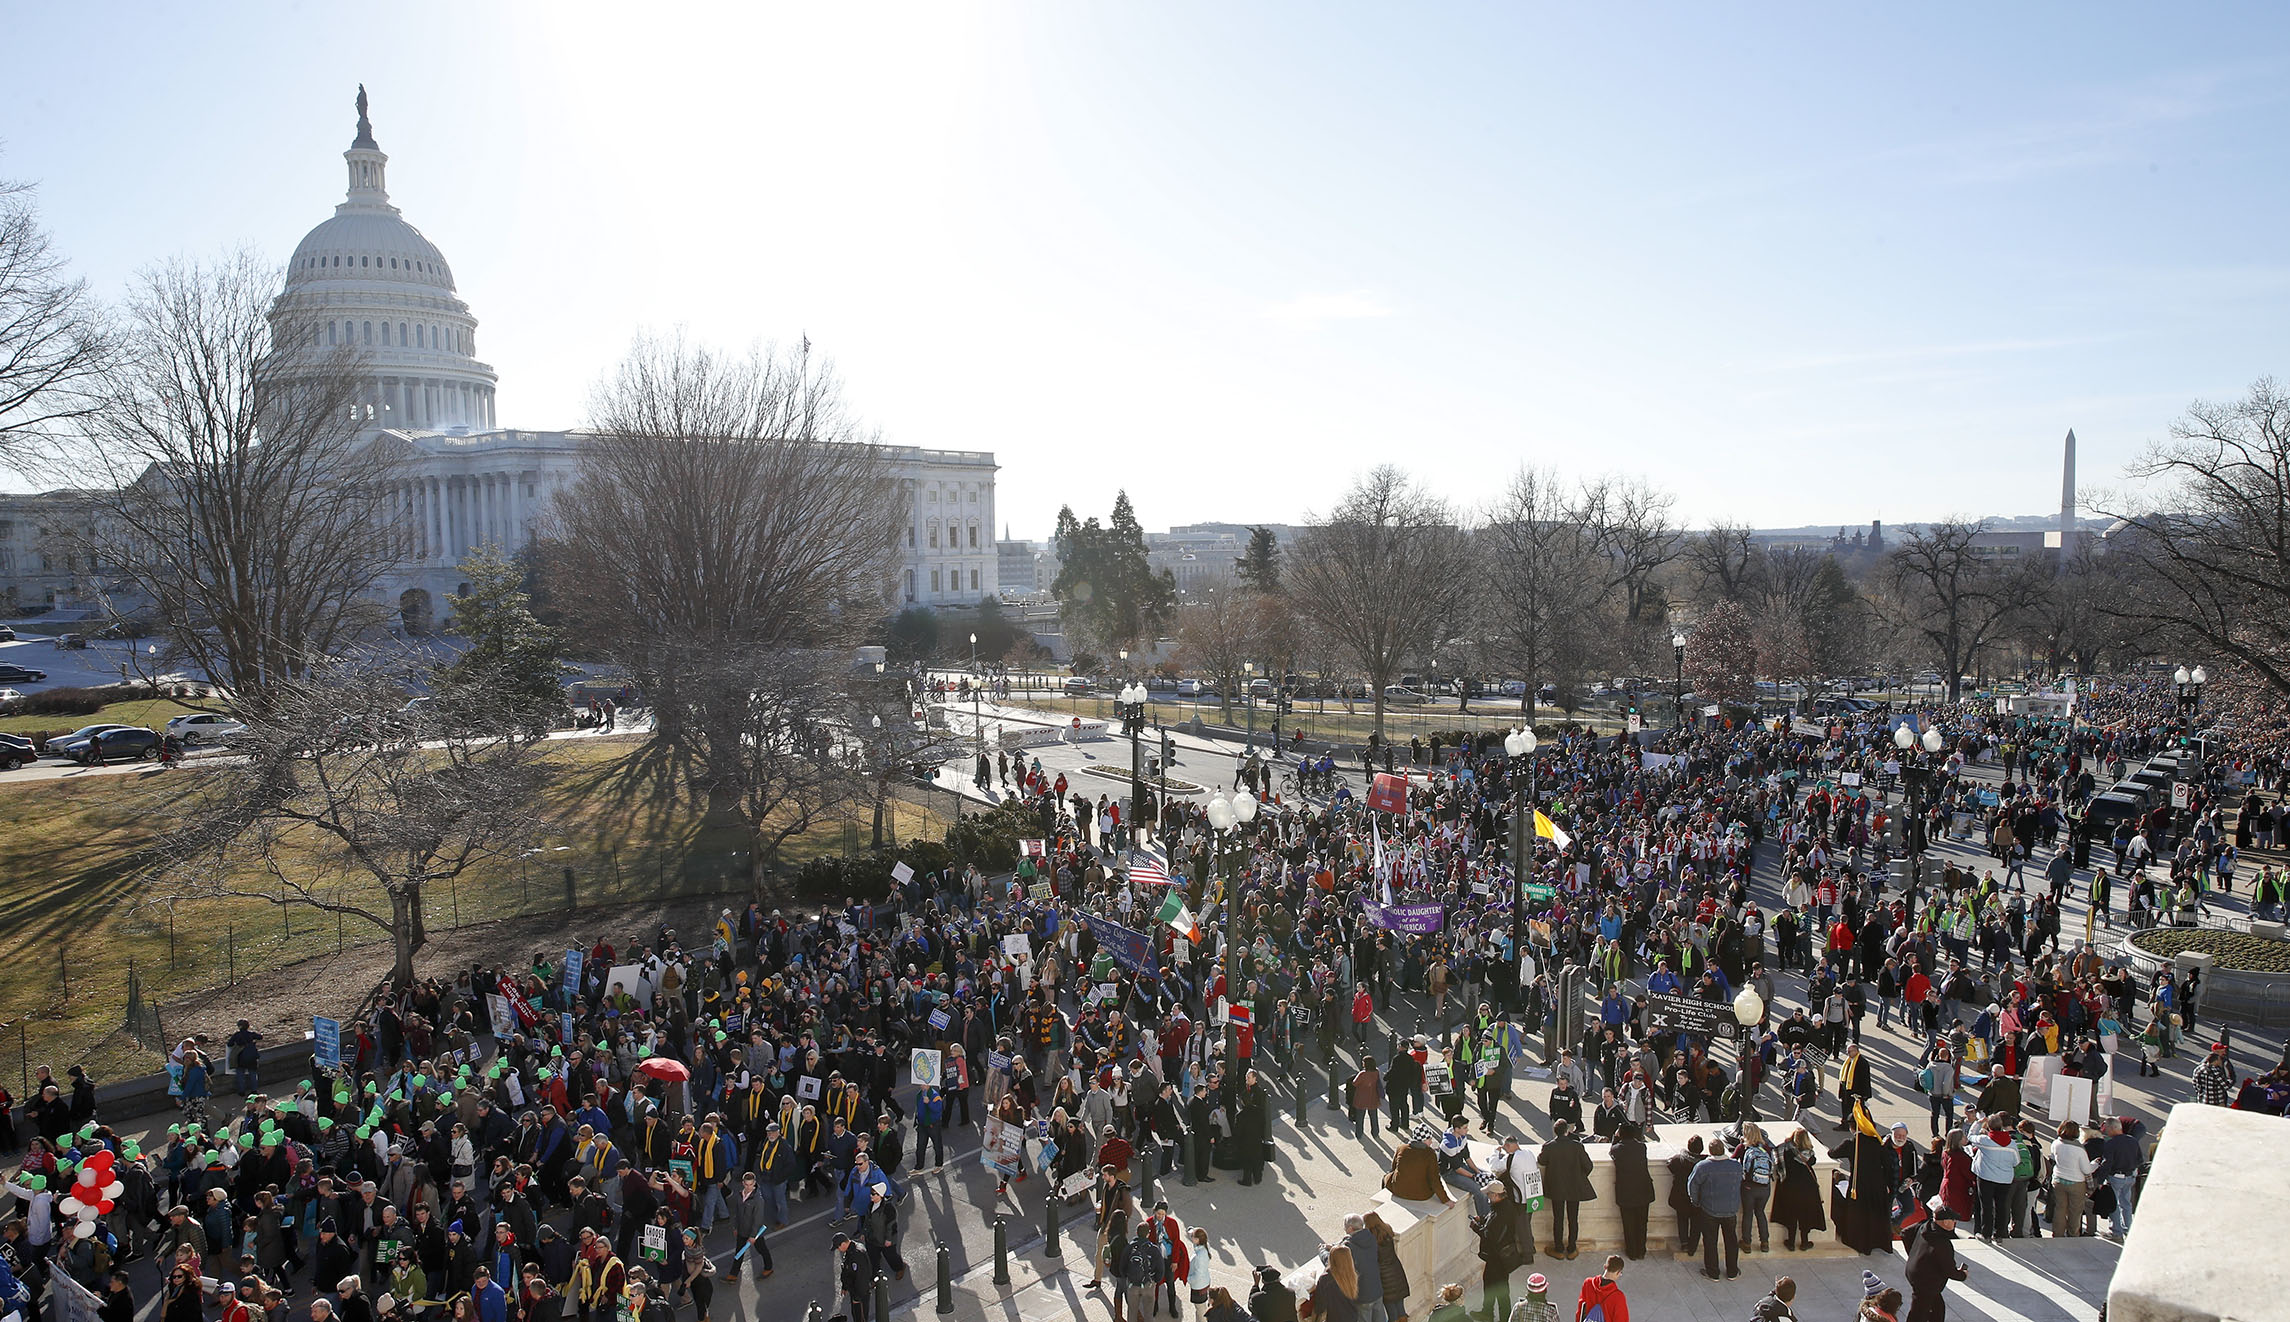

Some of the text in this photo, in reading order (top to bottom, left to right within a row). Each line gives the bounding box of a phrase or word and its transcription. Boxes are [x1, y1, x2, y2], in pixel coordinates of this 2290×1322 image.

[1408, 906, 1442, 916] DAUGHTERS
[1652, 993, 1734, 1012] XAVIER HIGH SCHOOL
[1664, 1006, 1696, 1015] Pro-Life
[1652, 1014, 1668, 1026] X
[1526, 1171, 1541, 1184] CHOOSE
[647, 1227, 663, 1239] CHOOSE
